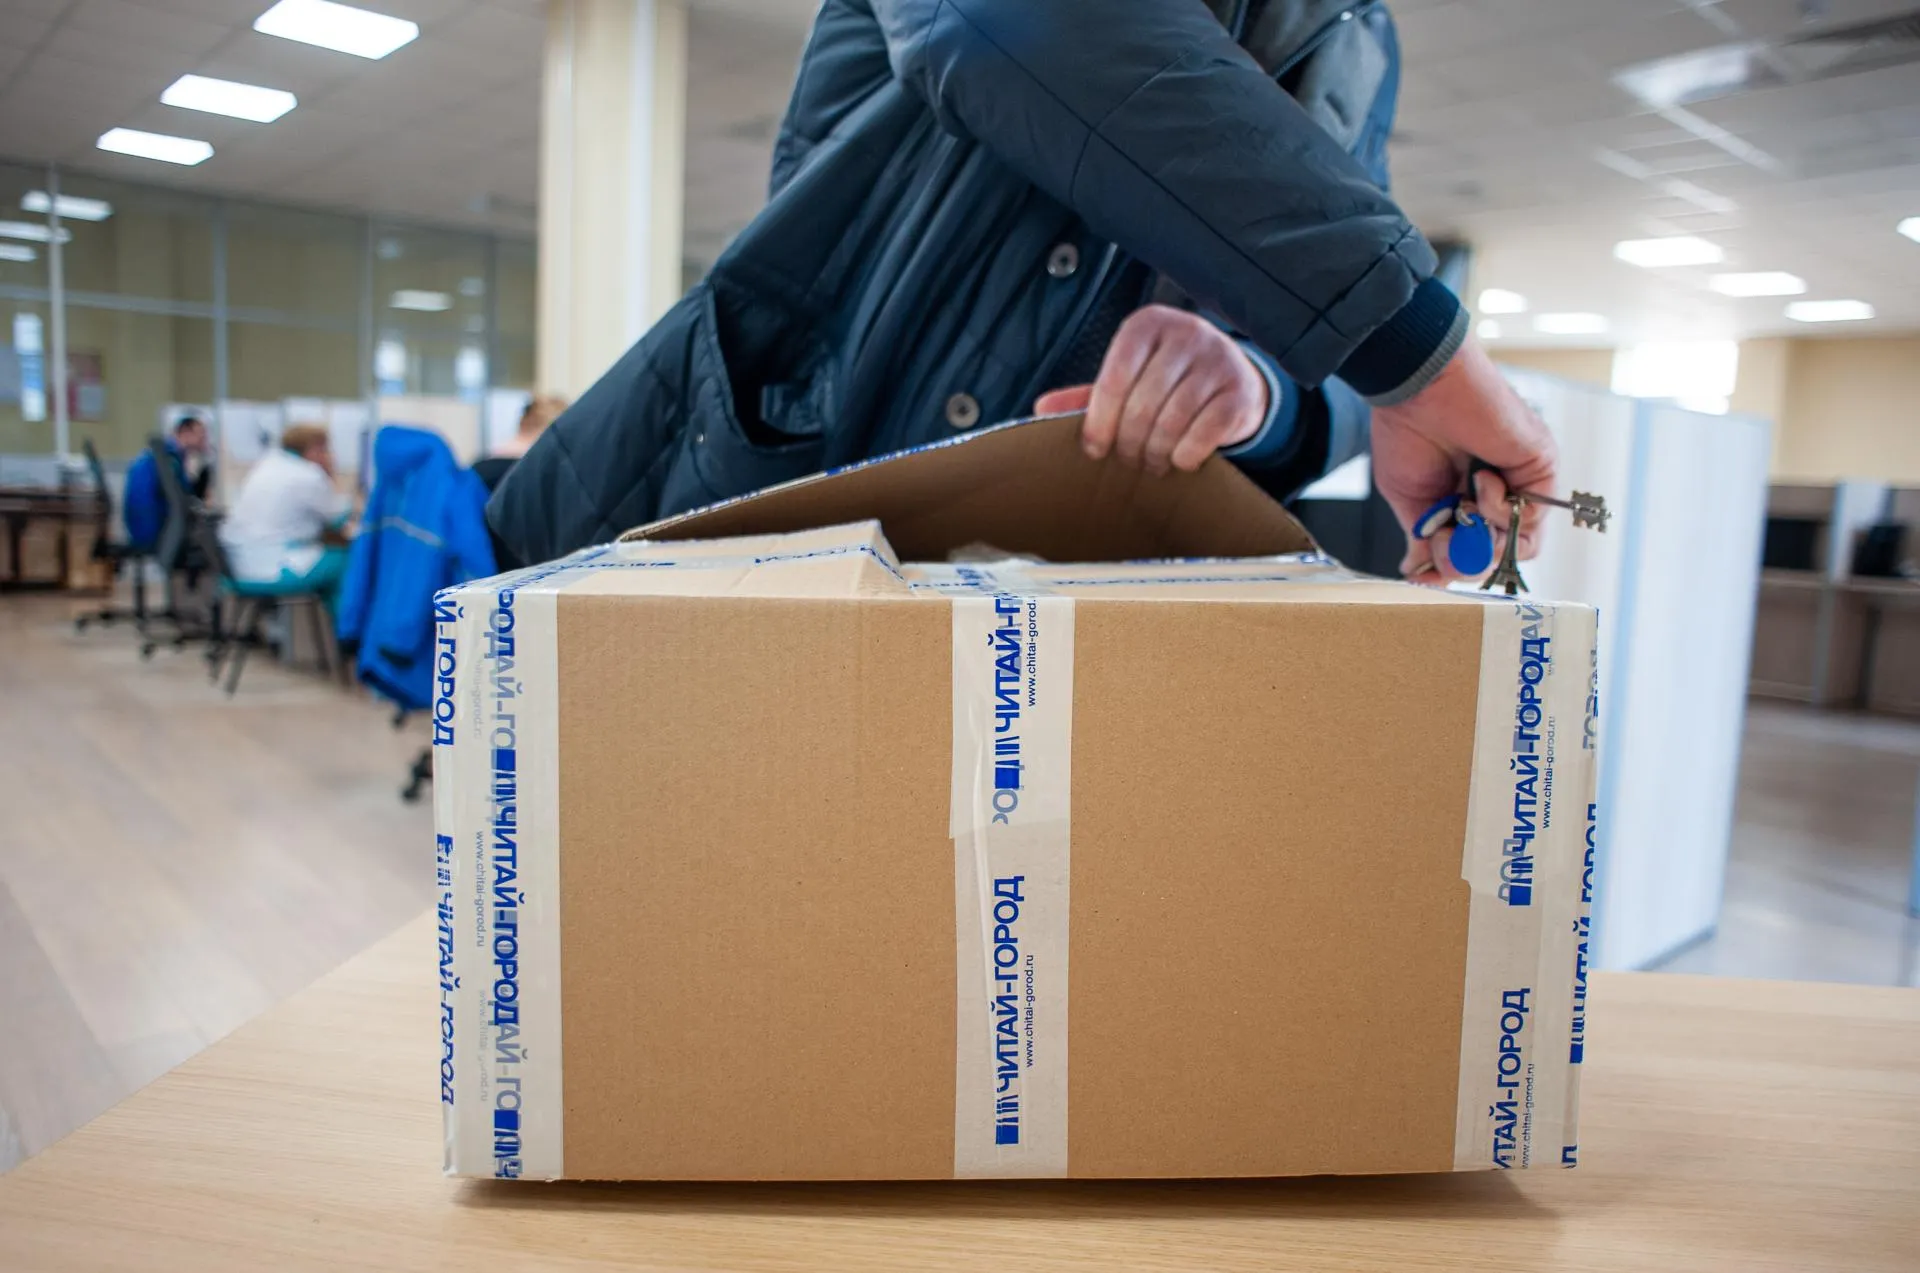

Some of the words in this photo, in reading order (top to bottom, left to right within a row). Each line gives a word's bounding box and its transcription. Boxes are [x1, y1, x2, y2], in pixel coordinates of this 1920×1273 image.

[1510, 637, 1550, 852] ЧИТАЙ-ГОРОД
[1543, 716, 1555, 829] www.chitai-gorod.ru
[474, 831, 487, 948] www.chitai-gorod.ru
[488, 806, 525, 1026] ЧИТАЙ-ГОРОД
[990, 875, 1025, 1093] ЧИТАЙ-ГОРОД
[437, 891, 460, 1105] ЧИТАЙ-ГОРОД
[1024, 955, 1036, 1068] www.chitai-gorod.ru
